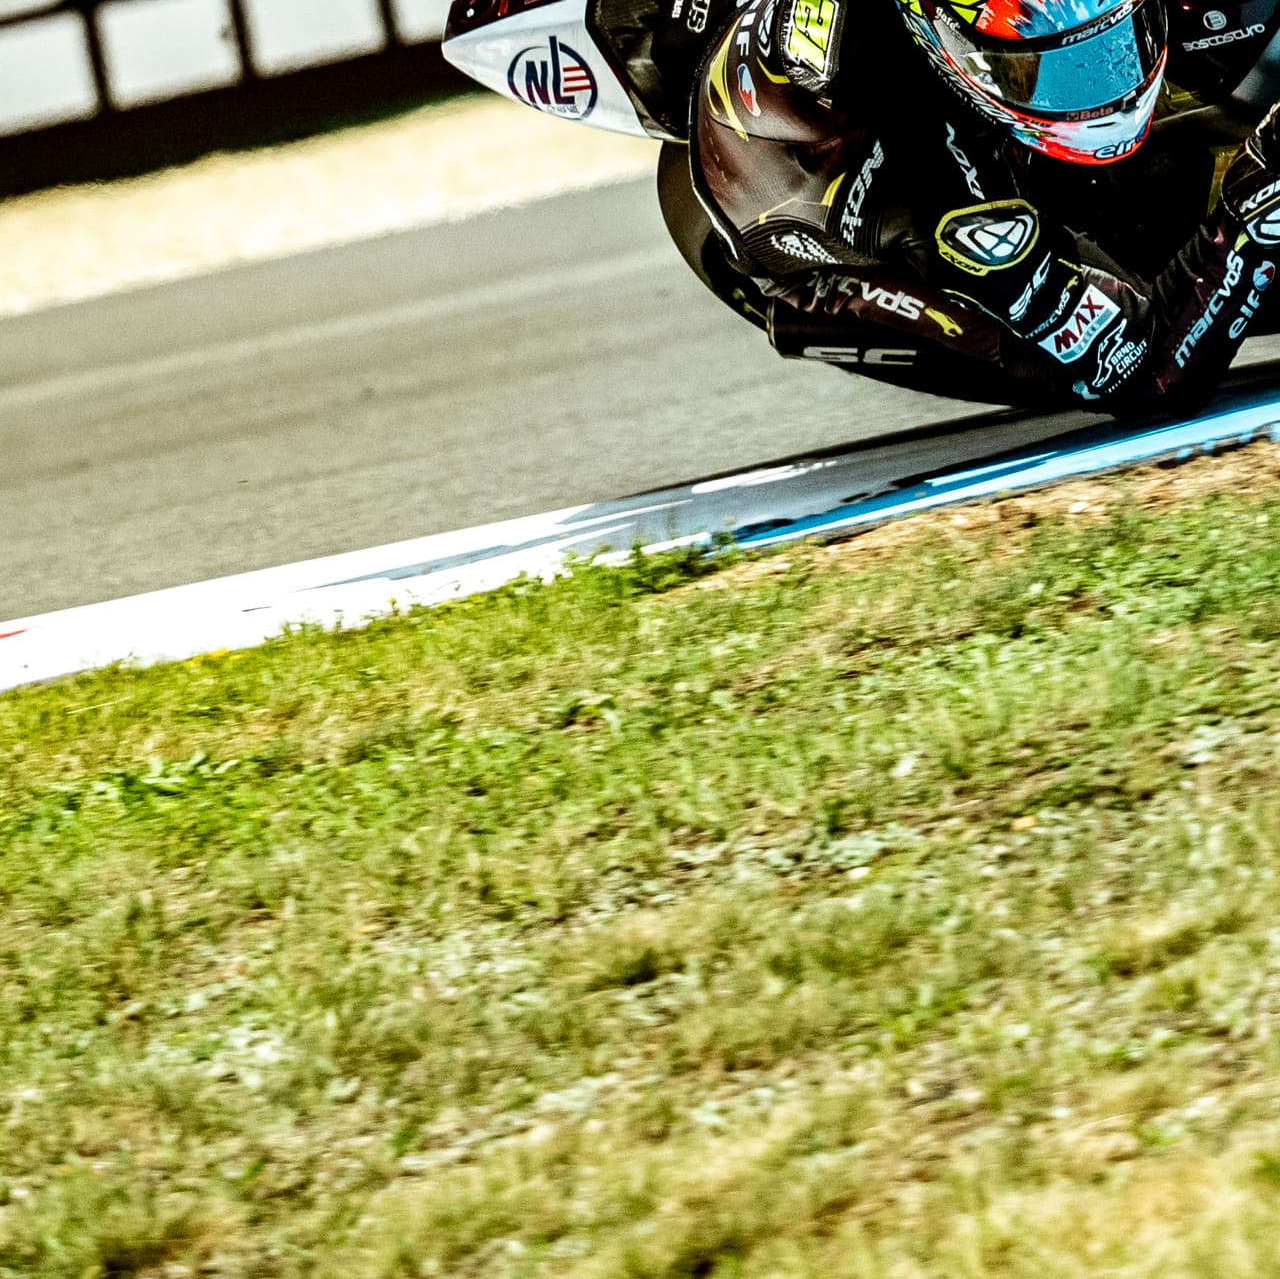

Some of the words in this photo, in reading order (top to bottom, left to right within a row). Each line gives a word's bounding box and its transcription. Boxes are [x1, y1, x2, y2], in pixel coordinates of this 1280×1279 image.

[1053, 294, 1105, 353] MAX
[1110, 340, 1136, 366] BRNO
[1115, 338, 1148, 374] CIRCUIT
